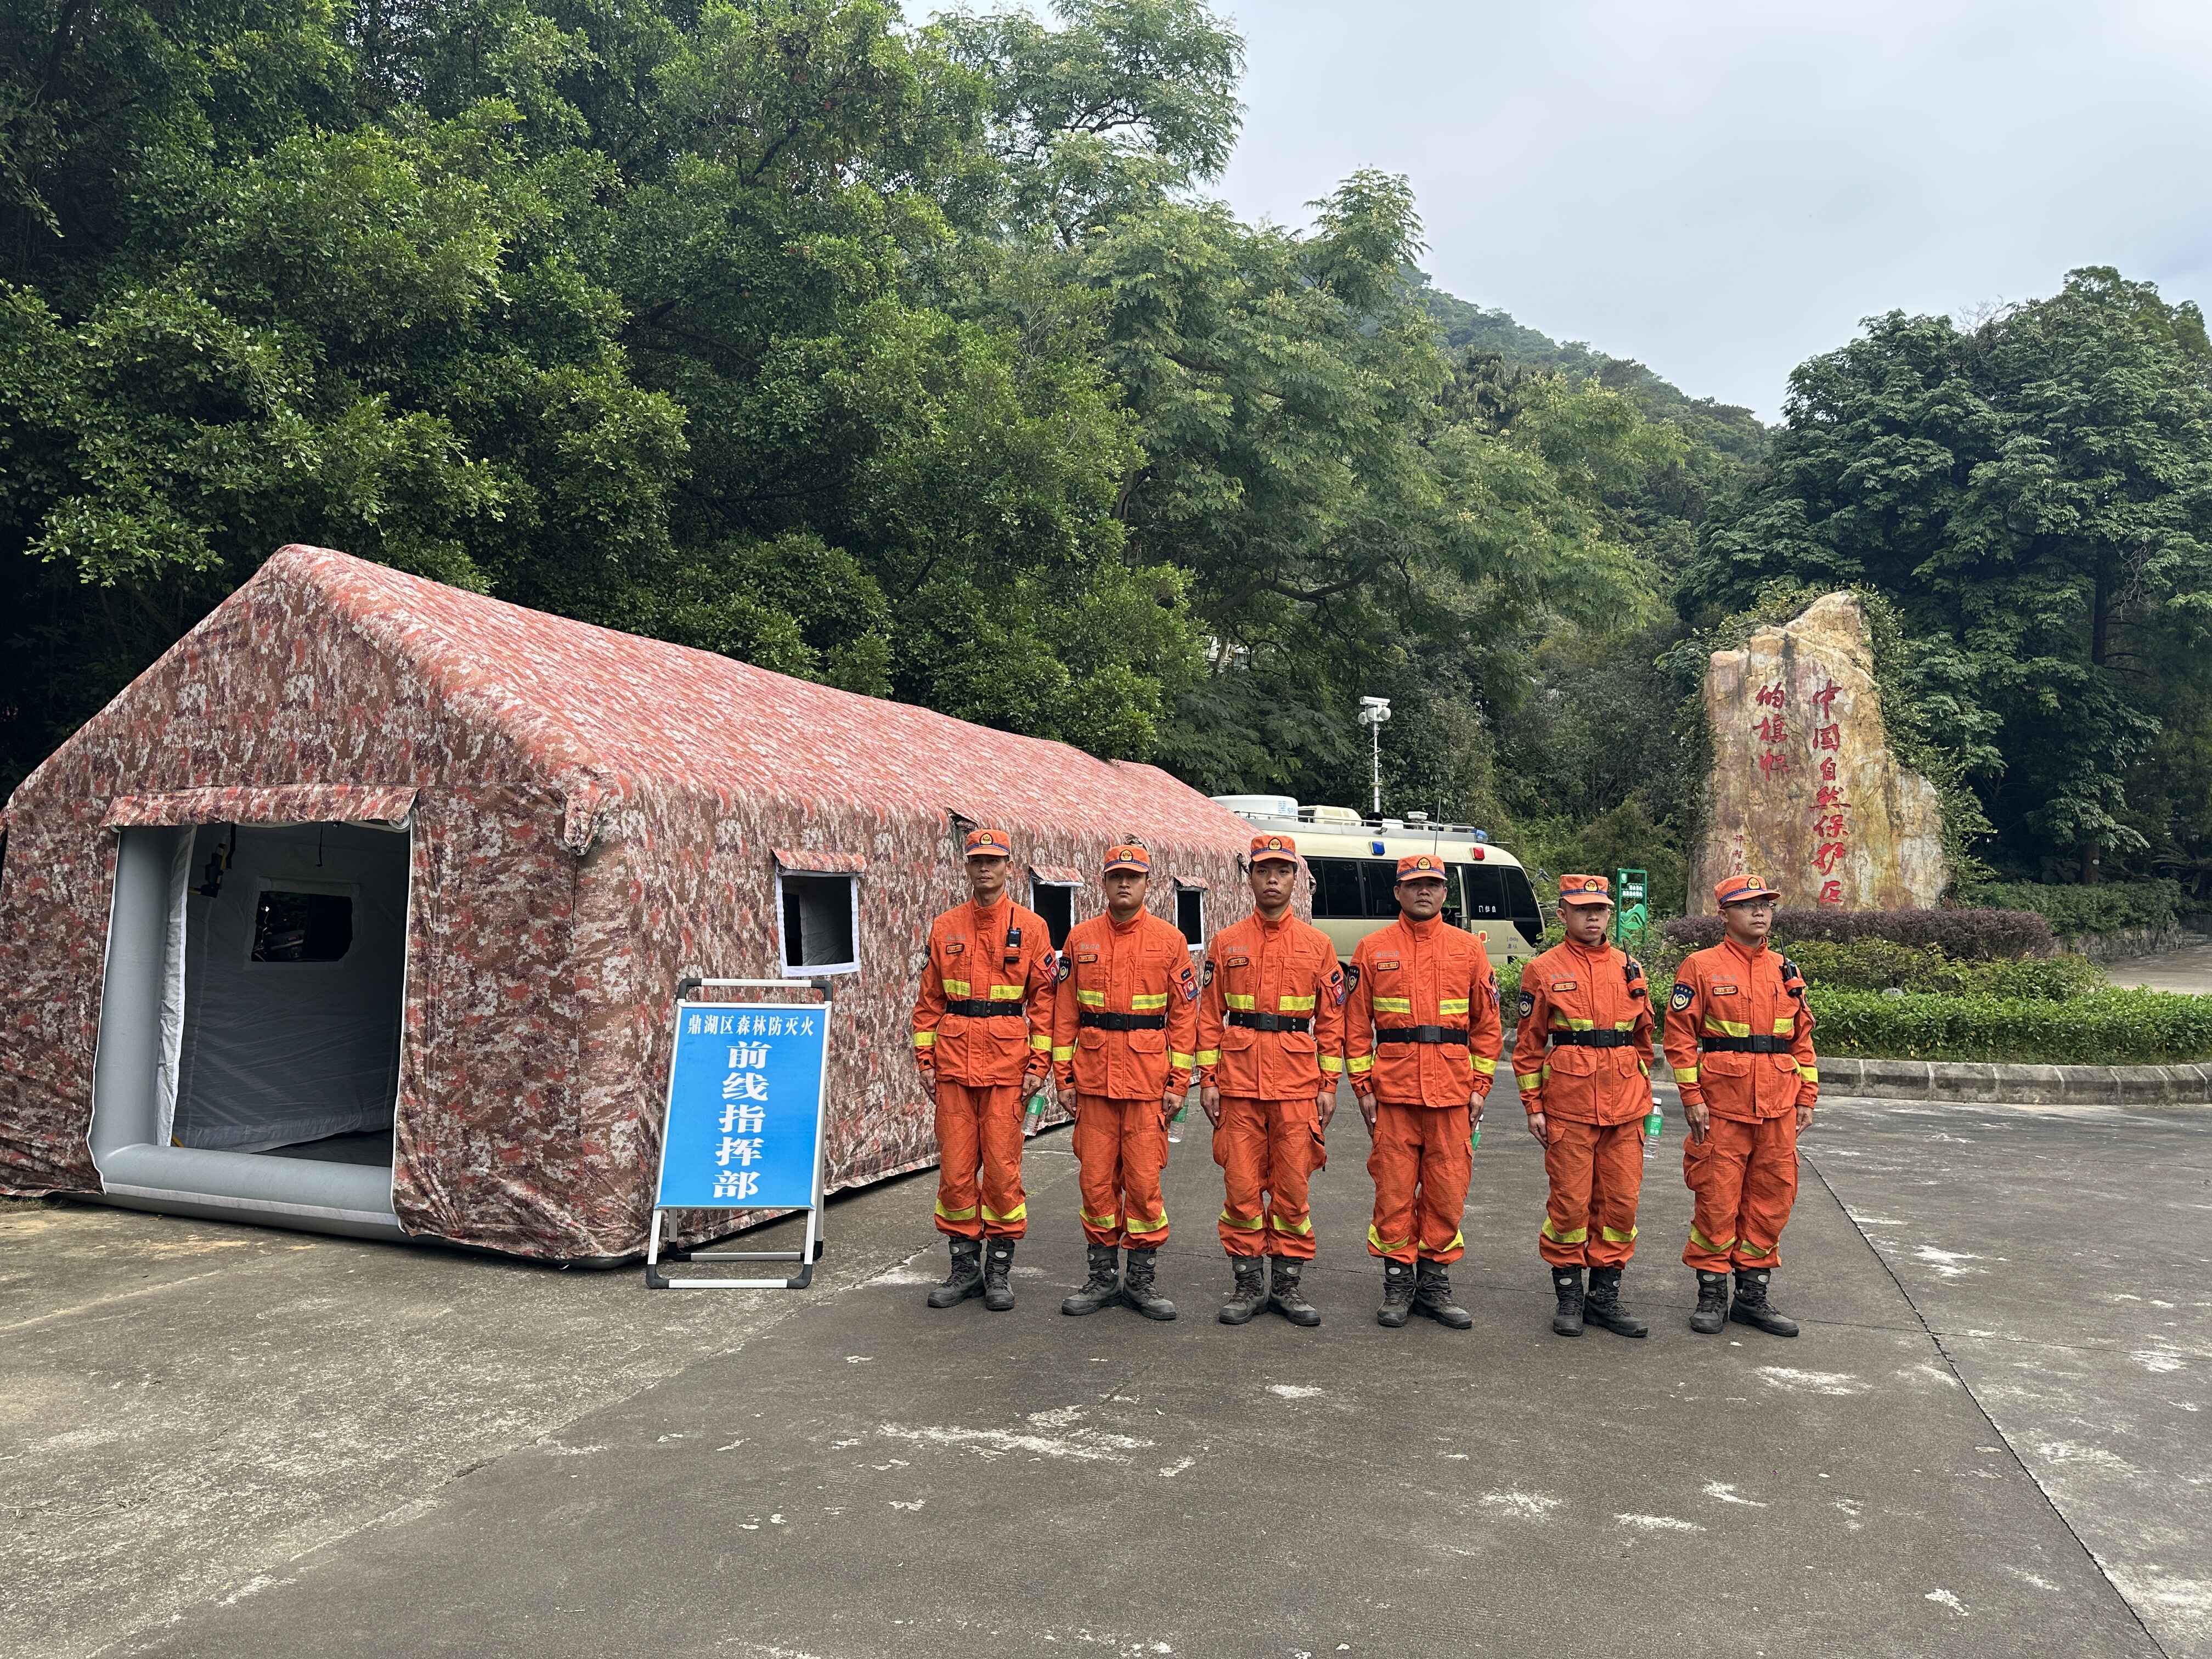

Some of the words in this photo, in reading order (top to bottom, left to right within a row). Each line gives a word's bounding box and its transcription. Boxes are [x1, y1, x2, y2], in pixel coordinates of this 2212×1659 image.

[1753, 682, 1789, 781] 的旗帜
[1809, 678, 1851, 902] 中国自然保护区
[687, 1014, 814, 1036] 鼎湖区森林防灭火
[713, 1041, 772, 1199] 前线指挥部
